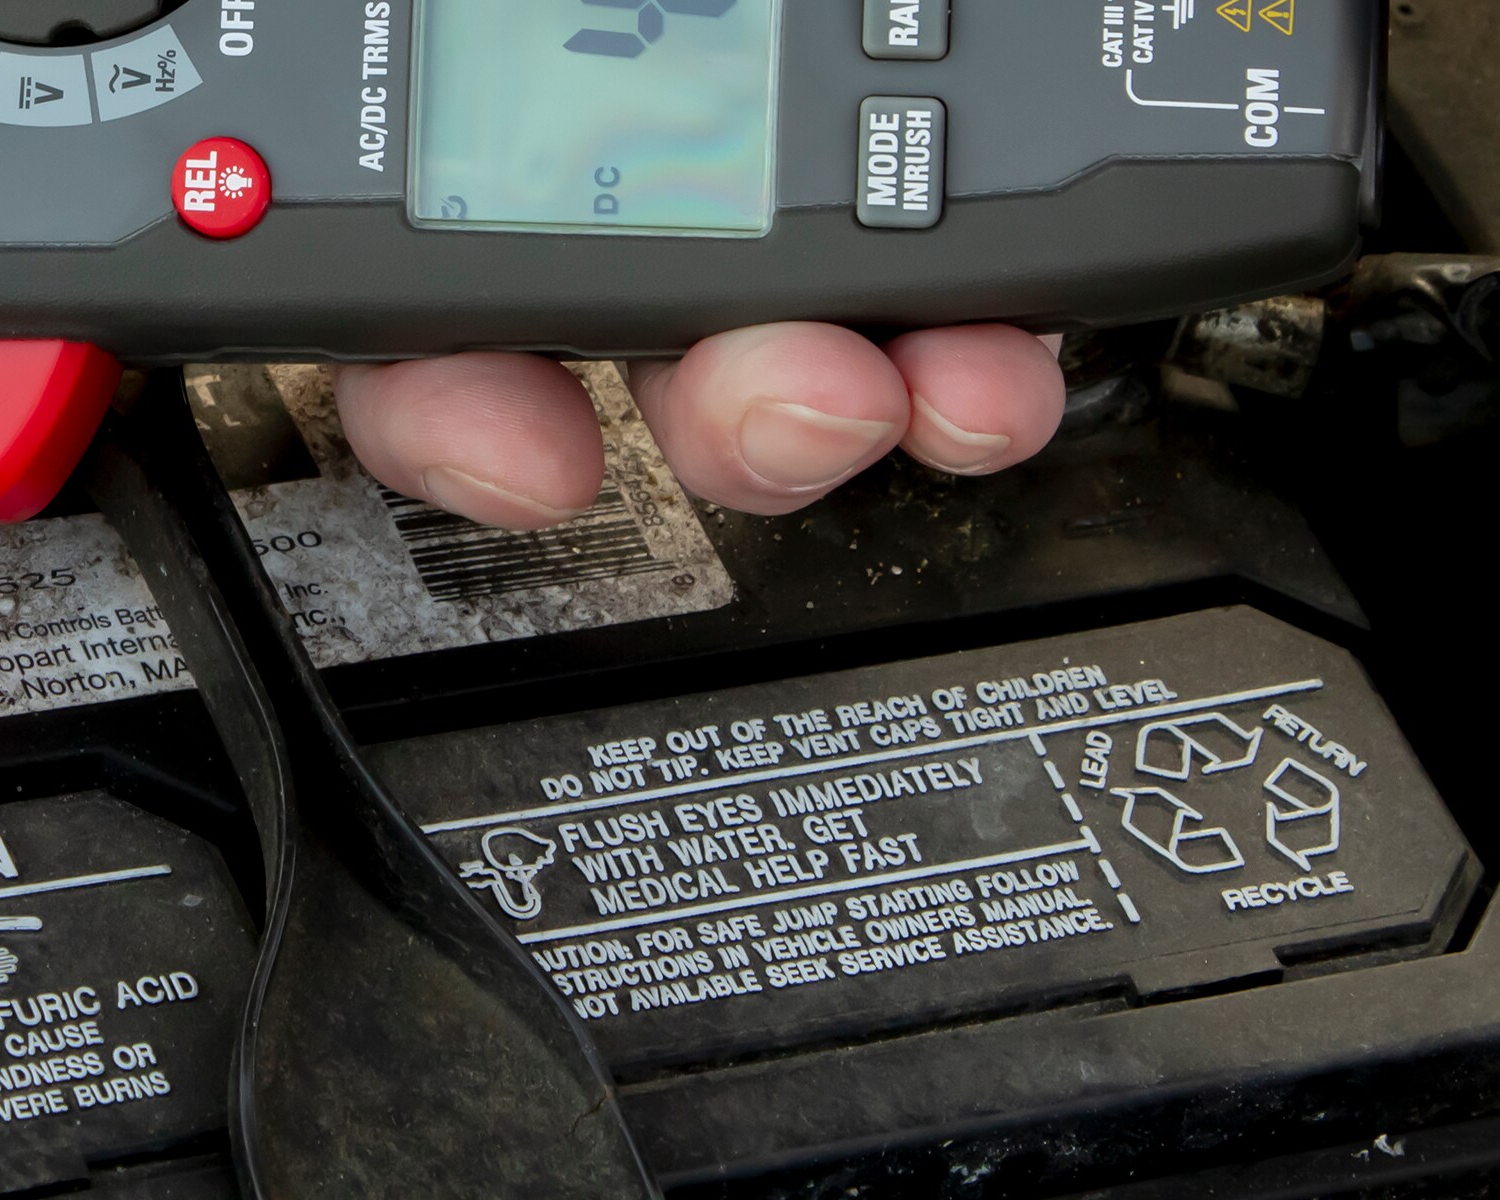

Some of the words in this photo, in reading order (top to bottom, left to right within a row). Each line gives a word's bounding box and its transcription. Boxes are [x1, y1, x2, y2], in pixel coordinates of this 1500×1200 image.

[361, 1, 390, 79] TRMS
[1103, 2, 1124, 27] III
[1133, 1, 1155, 22] IV
[154, 49, 178, 93] Hz%
[1102, 28, 1124, 68] CAT
[1132, 24, 1155, 64] CAT
[34, 81, 65, 105] V
[1244, 68, 1280, 148] COM
[358, 87, 388, 171] AC/DC
[183, 150, 218, 212] REL
[867, 113, 900, 206] MODE
[903, 110, 932, 211] INRUSH
[593, 165, 620, 215] DC
[14, 612, 111, 639] Controls
[114, 604, 165, 626] Batt
[285, 582, 329, 599] Inc.
[290, 609, 346, 628] nc.,
[21, 668, 136, 699] Norton,
[141, 657, 189, 682] MA
[540, 776, 584, 801] DO
[589, 764, 647, 793] NOT
[652, 756, 709, 783] TIP.
[716, 744, 785, 772] KEEP
[790, 731, 862, 761] VENT
[875, 717, 942, 747] CAPS
[945, 702, 1025, 733] TIGHT
[1035, 690, 1091, 720] AND
[1098, 678, 1178, 711] LEVEL
[587, 737, 658, 767] KEEP
[665, 724, 721, 754] OUT
[730, 718, 767, 745] OF
[774, 708, 829, 738] THE
[835, 693, 924, 727] REACH
[932, 685, 968, 711] OF
[976, 664, 1107, 703] CHILDREN
[1262, 703, 1367, 778] RETURN
[1079, 730, 1113, 790] LEAD
[558, 811, 671, 854] FLUSH
[680, 797, 763, 832] EYES
[768, 756, 984, 819] IMMEDIATELY
[572, 842, 665, 884] WITH
[667, 823, 796, 869] WATER.
[803, 808, 870, 843] GET
[589, 864, 741, 917] MEDICAL
[744, 850, 831, 891] HELP
[842, 833, 924, 871] FAST
[635, 929, 692, 958] FOR
[699, 916, 764, 946] SAFE
[772, 903, 838, 935] JUMP
[848, 879, 974, 921] STARTING
[980, 861, 1079, 900] FOLLOW
[1221, 871, 1355, 911] RECYCLE
[551, 952, 714, 997] STRUCTIONS
[717, 944, 750, 971] IN
[754, 925, 864, 963] VEHICLE
[870, 906, 976, 944] OWNERS
[991, 887, 1093, 926] MANUAL.
[630, 970, 763, 1011] AVAILABLE
[768, 958, 836, 989] SEEK
[840, 936, 947, 978] SERVICE
[953, 906, 1115, 957] ASSISTANCE.
[116, 970, 199, 1010] ACID
[4, 1021, 104, 1058] CAUSE
[112, 1042, 157, 1071] OR
[73, 1071, 172, 1109] BURNS
